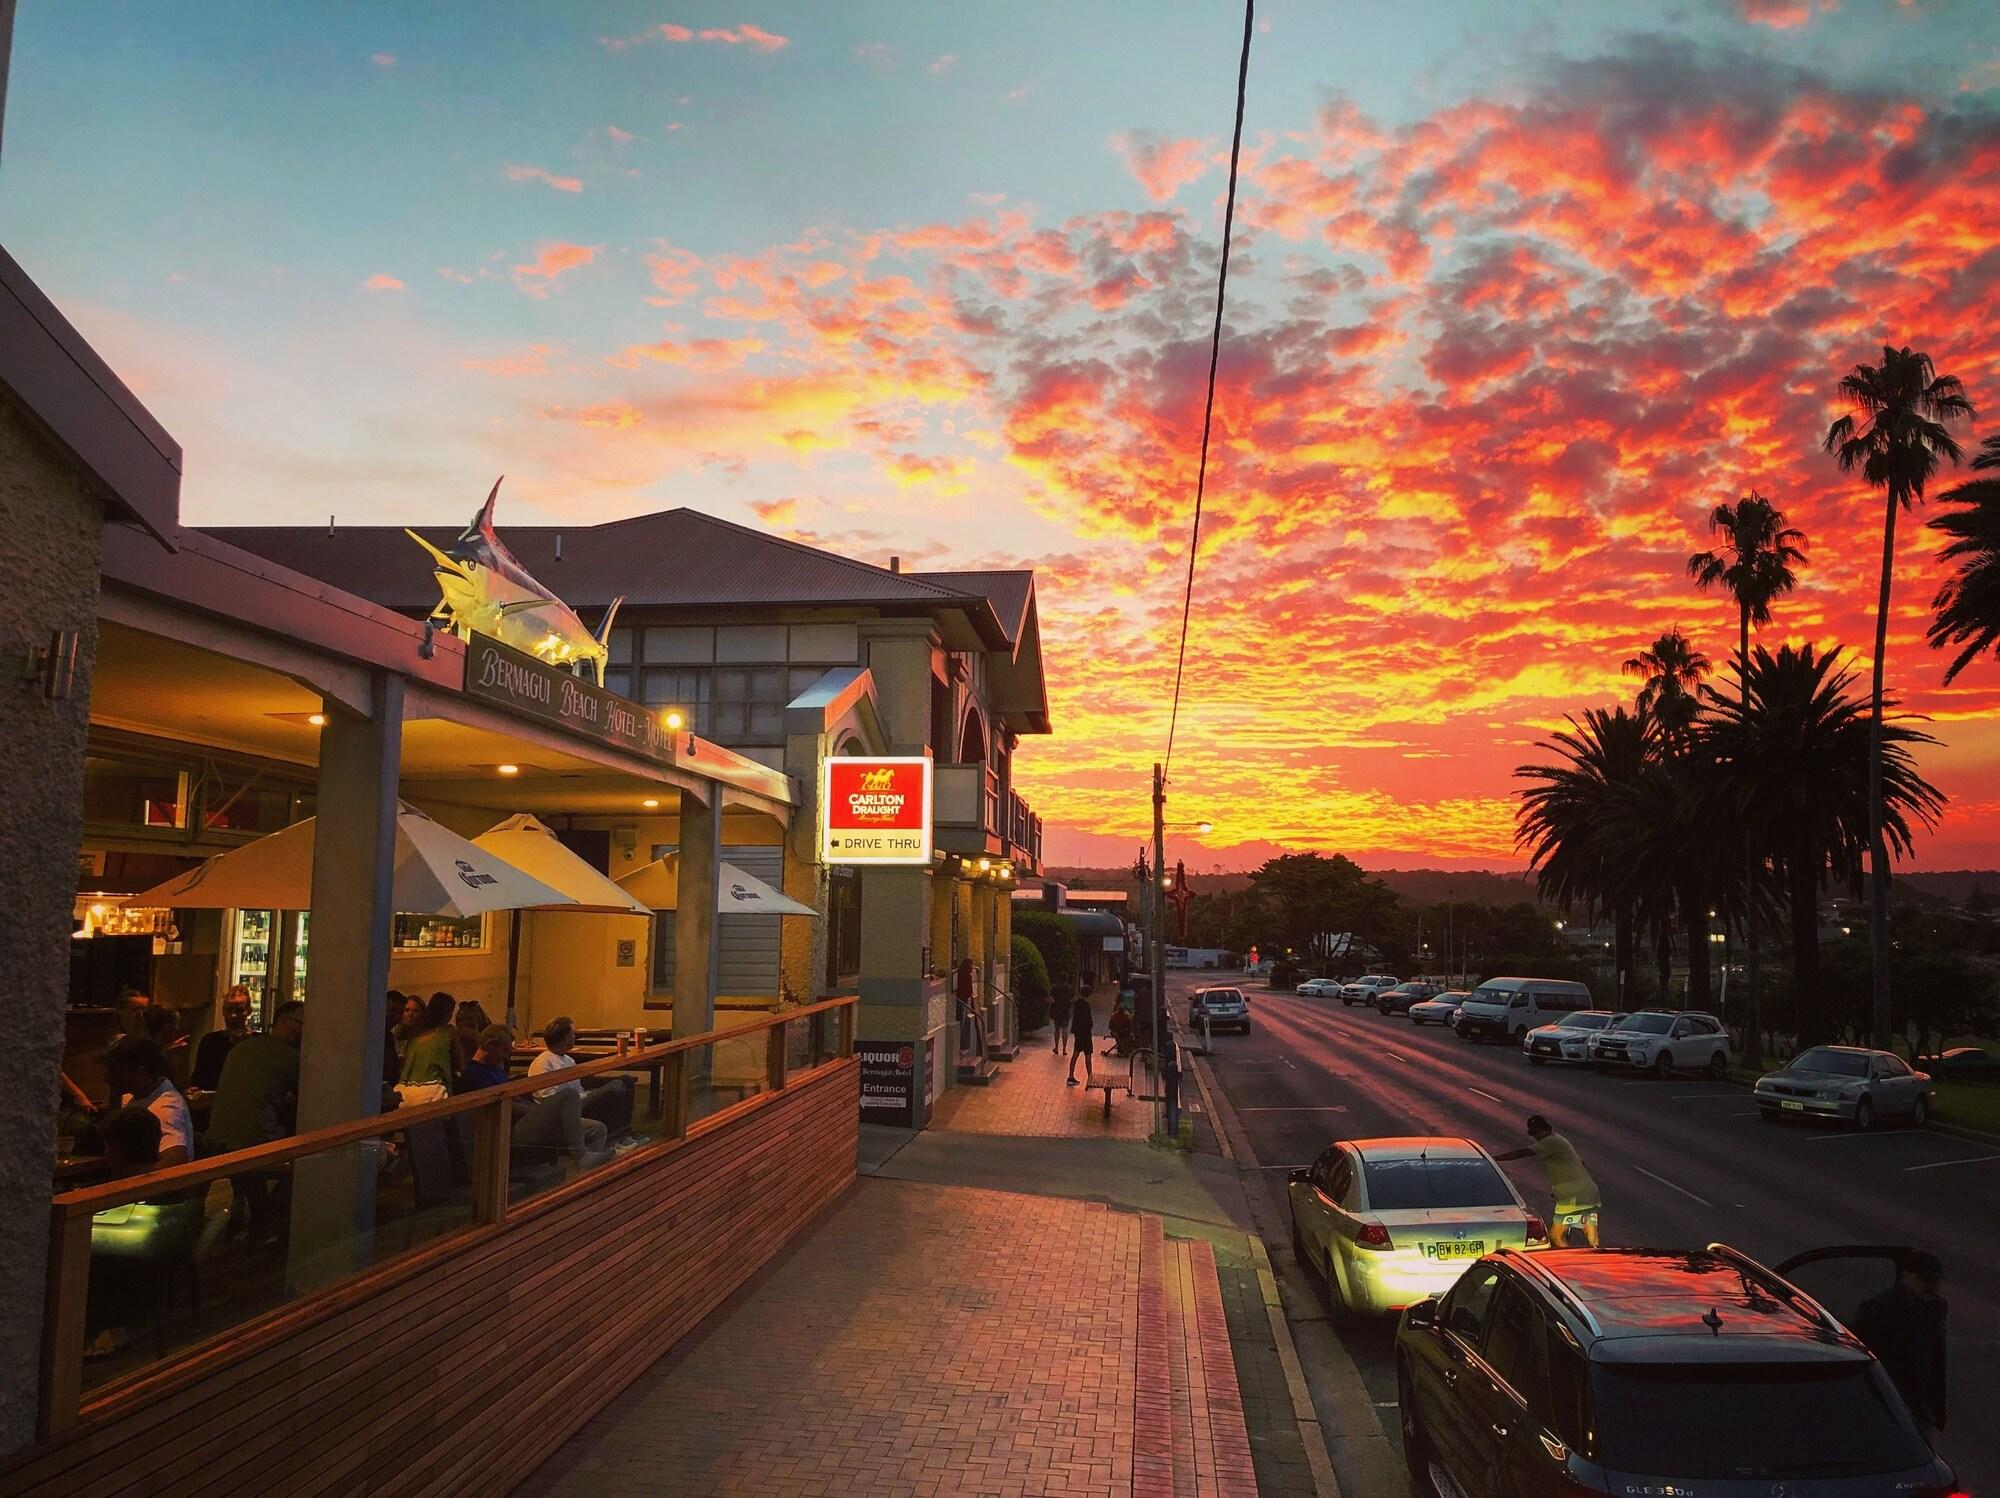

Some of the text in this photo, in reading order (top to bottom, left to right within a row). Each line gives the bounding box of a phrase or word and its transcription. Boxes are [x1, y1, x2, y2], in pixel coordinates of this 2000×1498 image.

[478, 647, 551, 704] BERMAGUI
[559, 679, 598, 722] BEACH
[848, 793, 905, 805] CARLTON
[852, 805, 901, 815] DRAUGHT
[845, 838, 921, 849] DRIVE THRU
[863, 1083, 907, 1094] Entrance
[1625, 1485, 1652, 1495] GLE
